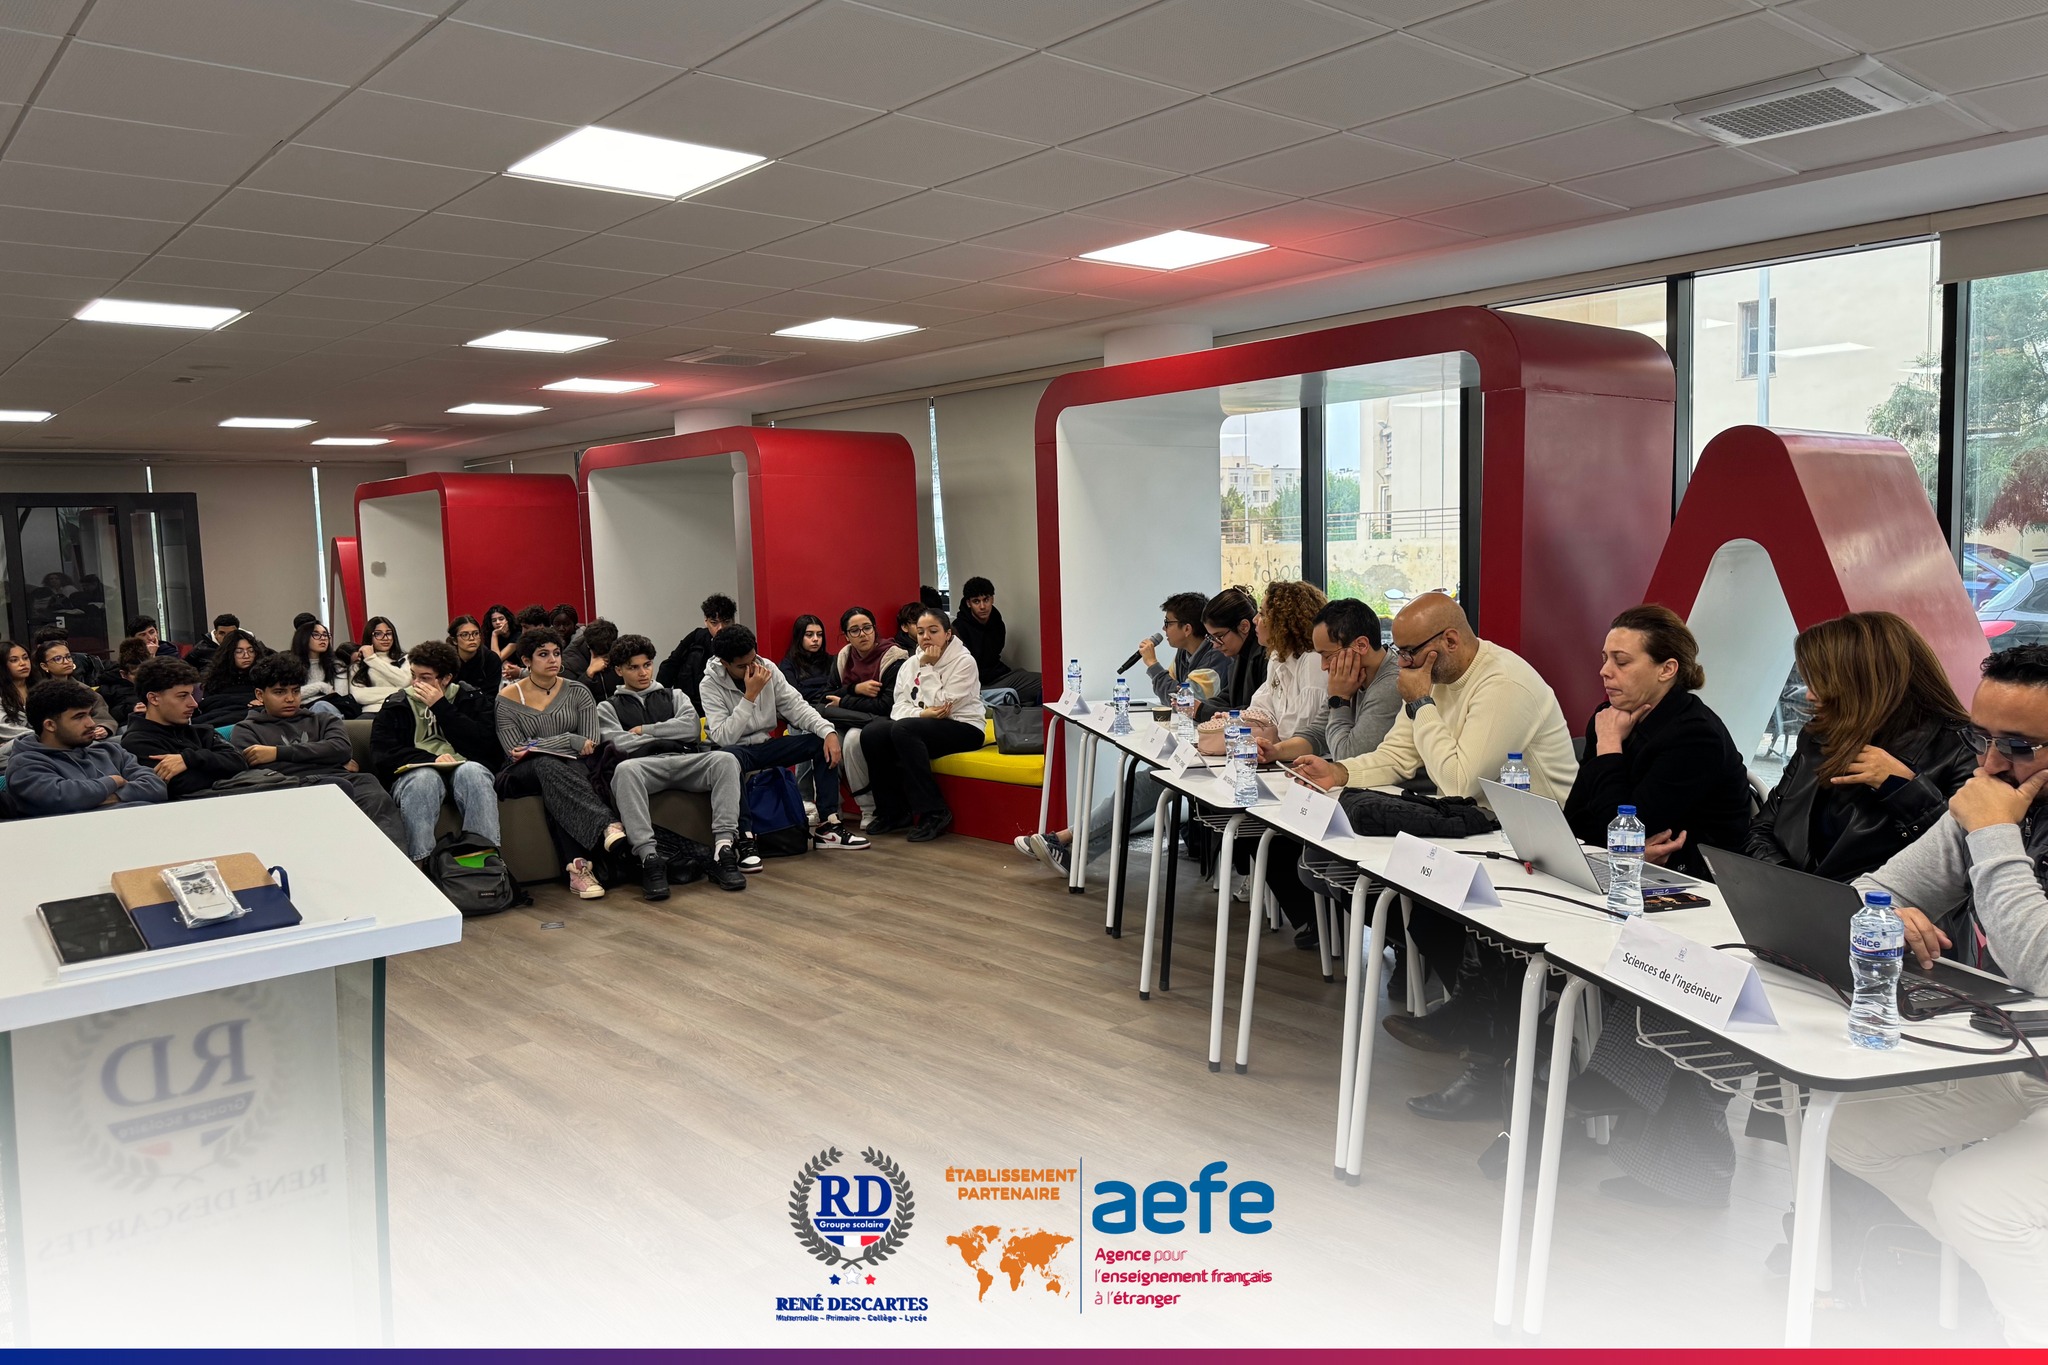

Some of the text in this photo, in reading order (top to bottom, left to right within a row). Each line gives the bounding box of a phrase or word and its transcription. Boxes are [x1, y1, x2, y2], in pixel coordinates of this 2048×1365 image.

[1420, 866, 1433, 877] NSI
[1852, 935, 1881, 949] délice
[1622, 952, 1657, 977] Sciences
[1658, 969, 1672, 982] de
